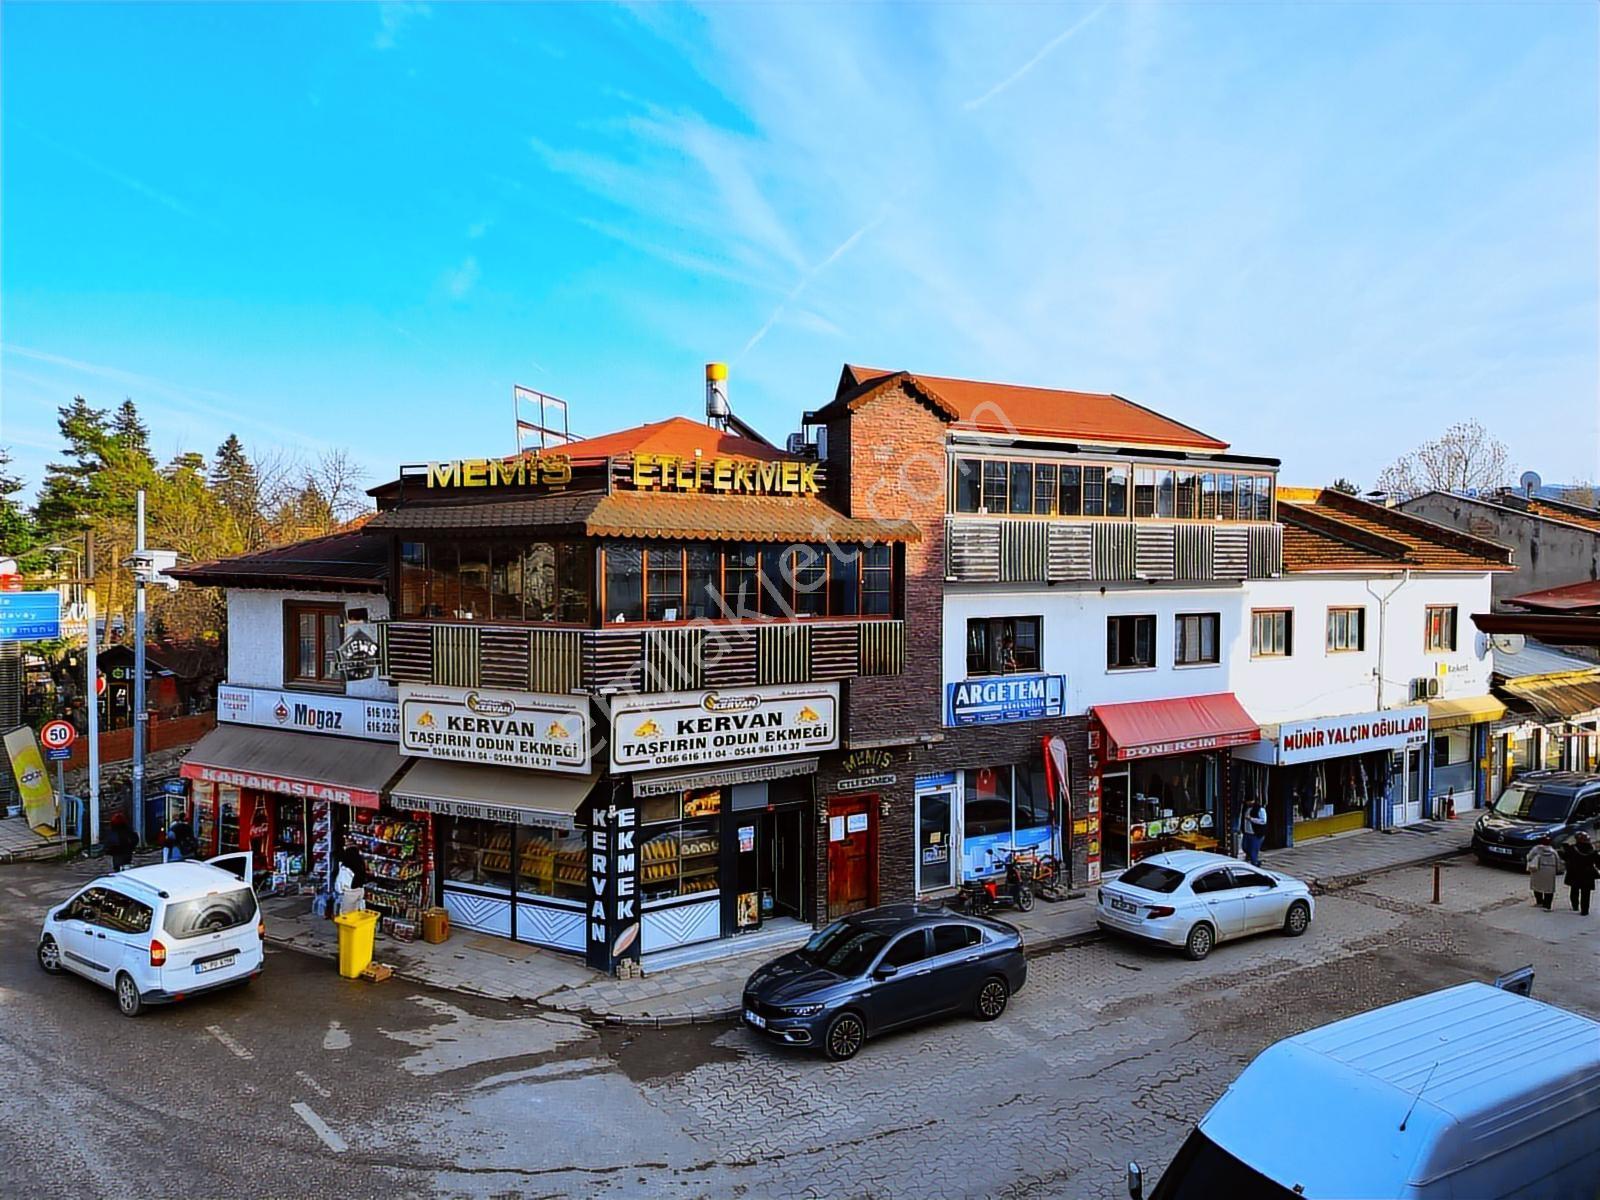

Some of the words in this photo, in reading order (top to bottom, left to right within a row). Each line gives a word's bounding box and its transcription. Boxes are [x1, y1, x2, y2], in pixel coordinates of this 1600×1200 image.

[713, 457, 819, 494] EKMEK
[956, 679, 1044, 705] ARGETEM
[294, 703, 342, 730] Mogaz
[447, 716, 535, 737] KERVAN
[677, 712, 782, 735] KERVAN
[50, 728, 67, 741] 50
[410, 731, 472, 748] TAŞFIRIN
[475, 738, 514, 751] ODUN
[623, 736, 706, 757] TAŞFIRIN
[713, 732, 759, 748] ODUN
[765, 723, 828, 742] EKMEĞİ
[1284, 727, 1324, 751] MÜNİR
[1327, 723, 1370, 745] YALÇIN
[1372, 716, 1426, 738] OĞULLARI
[432, 748, 450, 757] 0366
[655, 754, 680, 765] 0366
[681, 752, 699, 763] 616
[703, 751, 712, 760] 11
[715, 749, 726, 759] 04
[734, 746, 756, 756] 0544
[758, 744, 774, 754] 961
[777, 743, 788, 753] 14
[789, 742, 800, 751] 37
[592, 808, 607, 943] KERVAN
[618, 807, 635, 920] EKMEK
